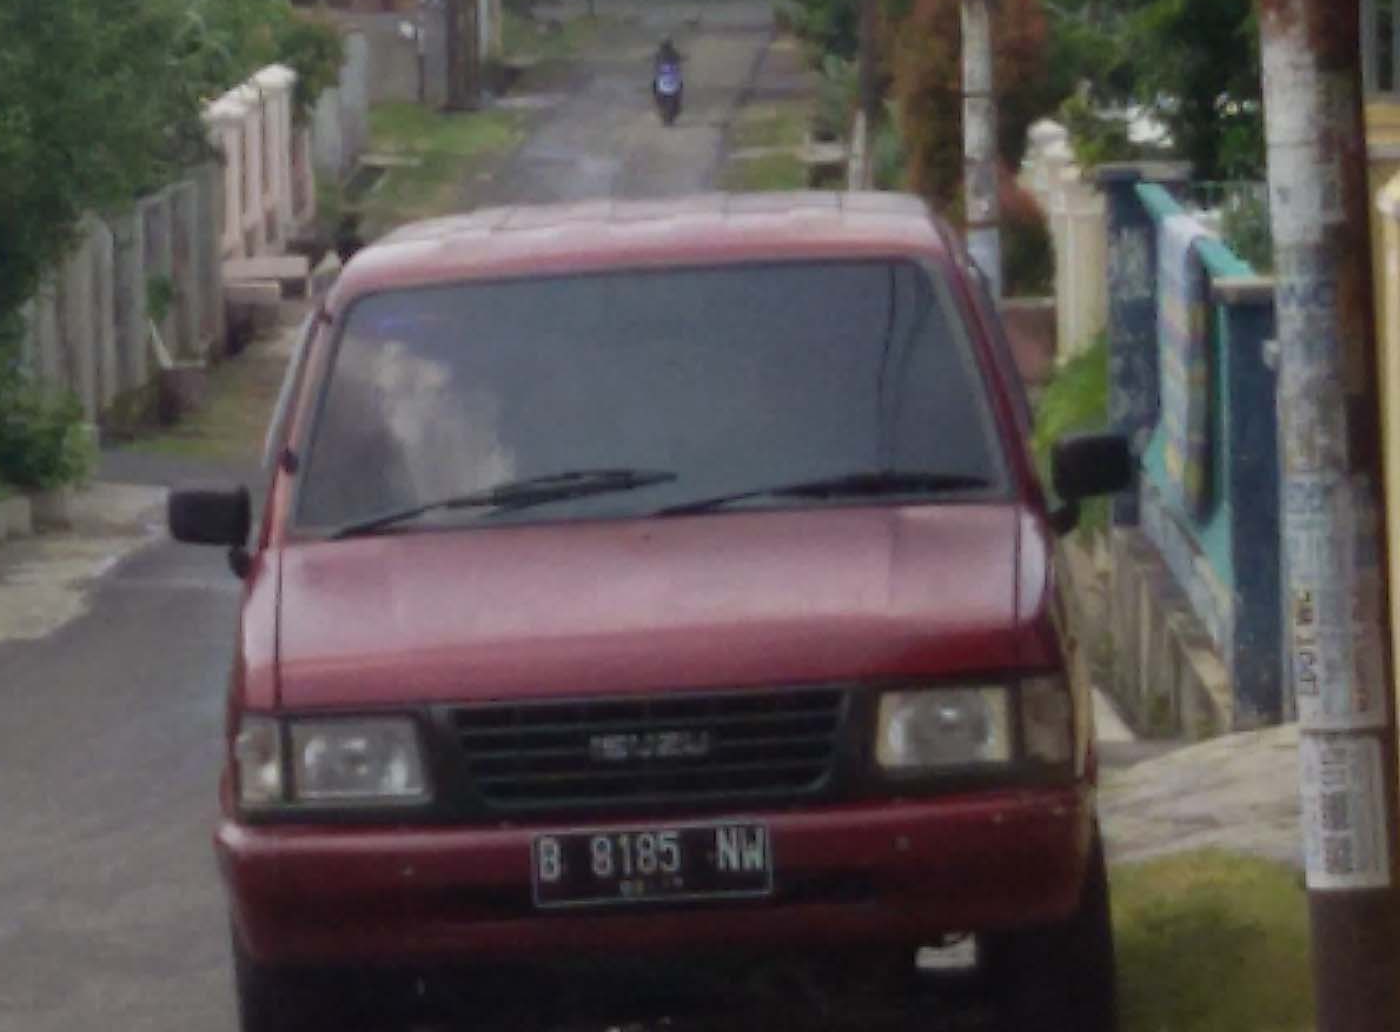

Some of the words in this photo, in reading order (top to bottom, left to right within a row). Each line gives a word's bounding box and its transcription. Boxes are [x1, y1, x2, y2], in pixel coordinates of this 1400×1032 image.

[539, 835, 562, 882] B
[590, 830, 681, 877] 8185
[715, 826, 766, 872] NW
